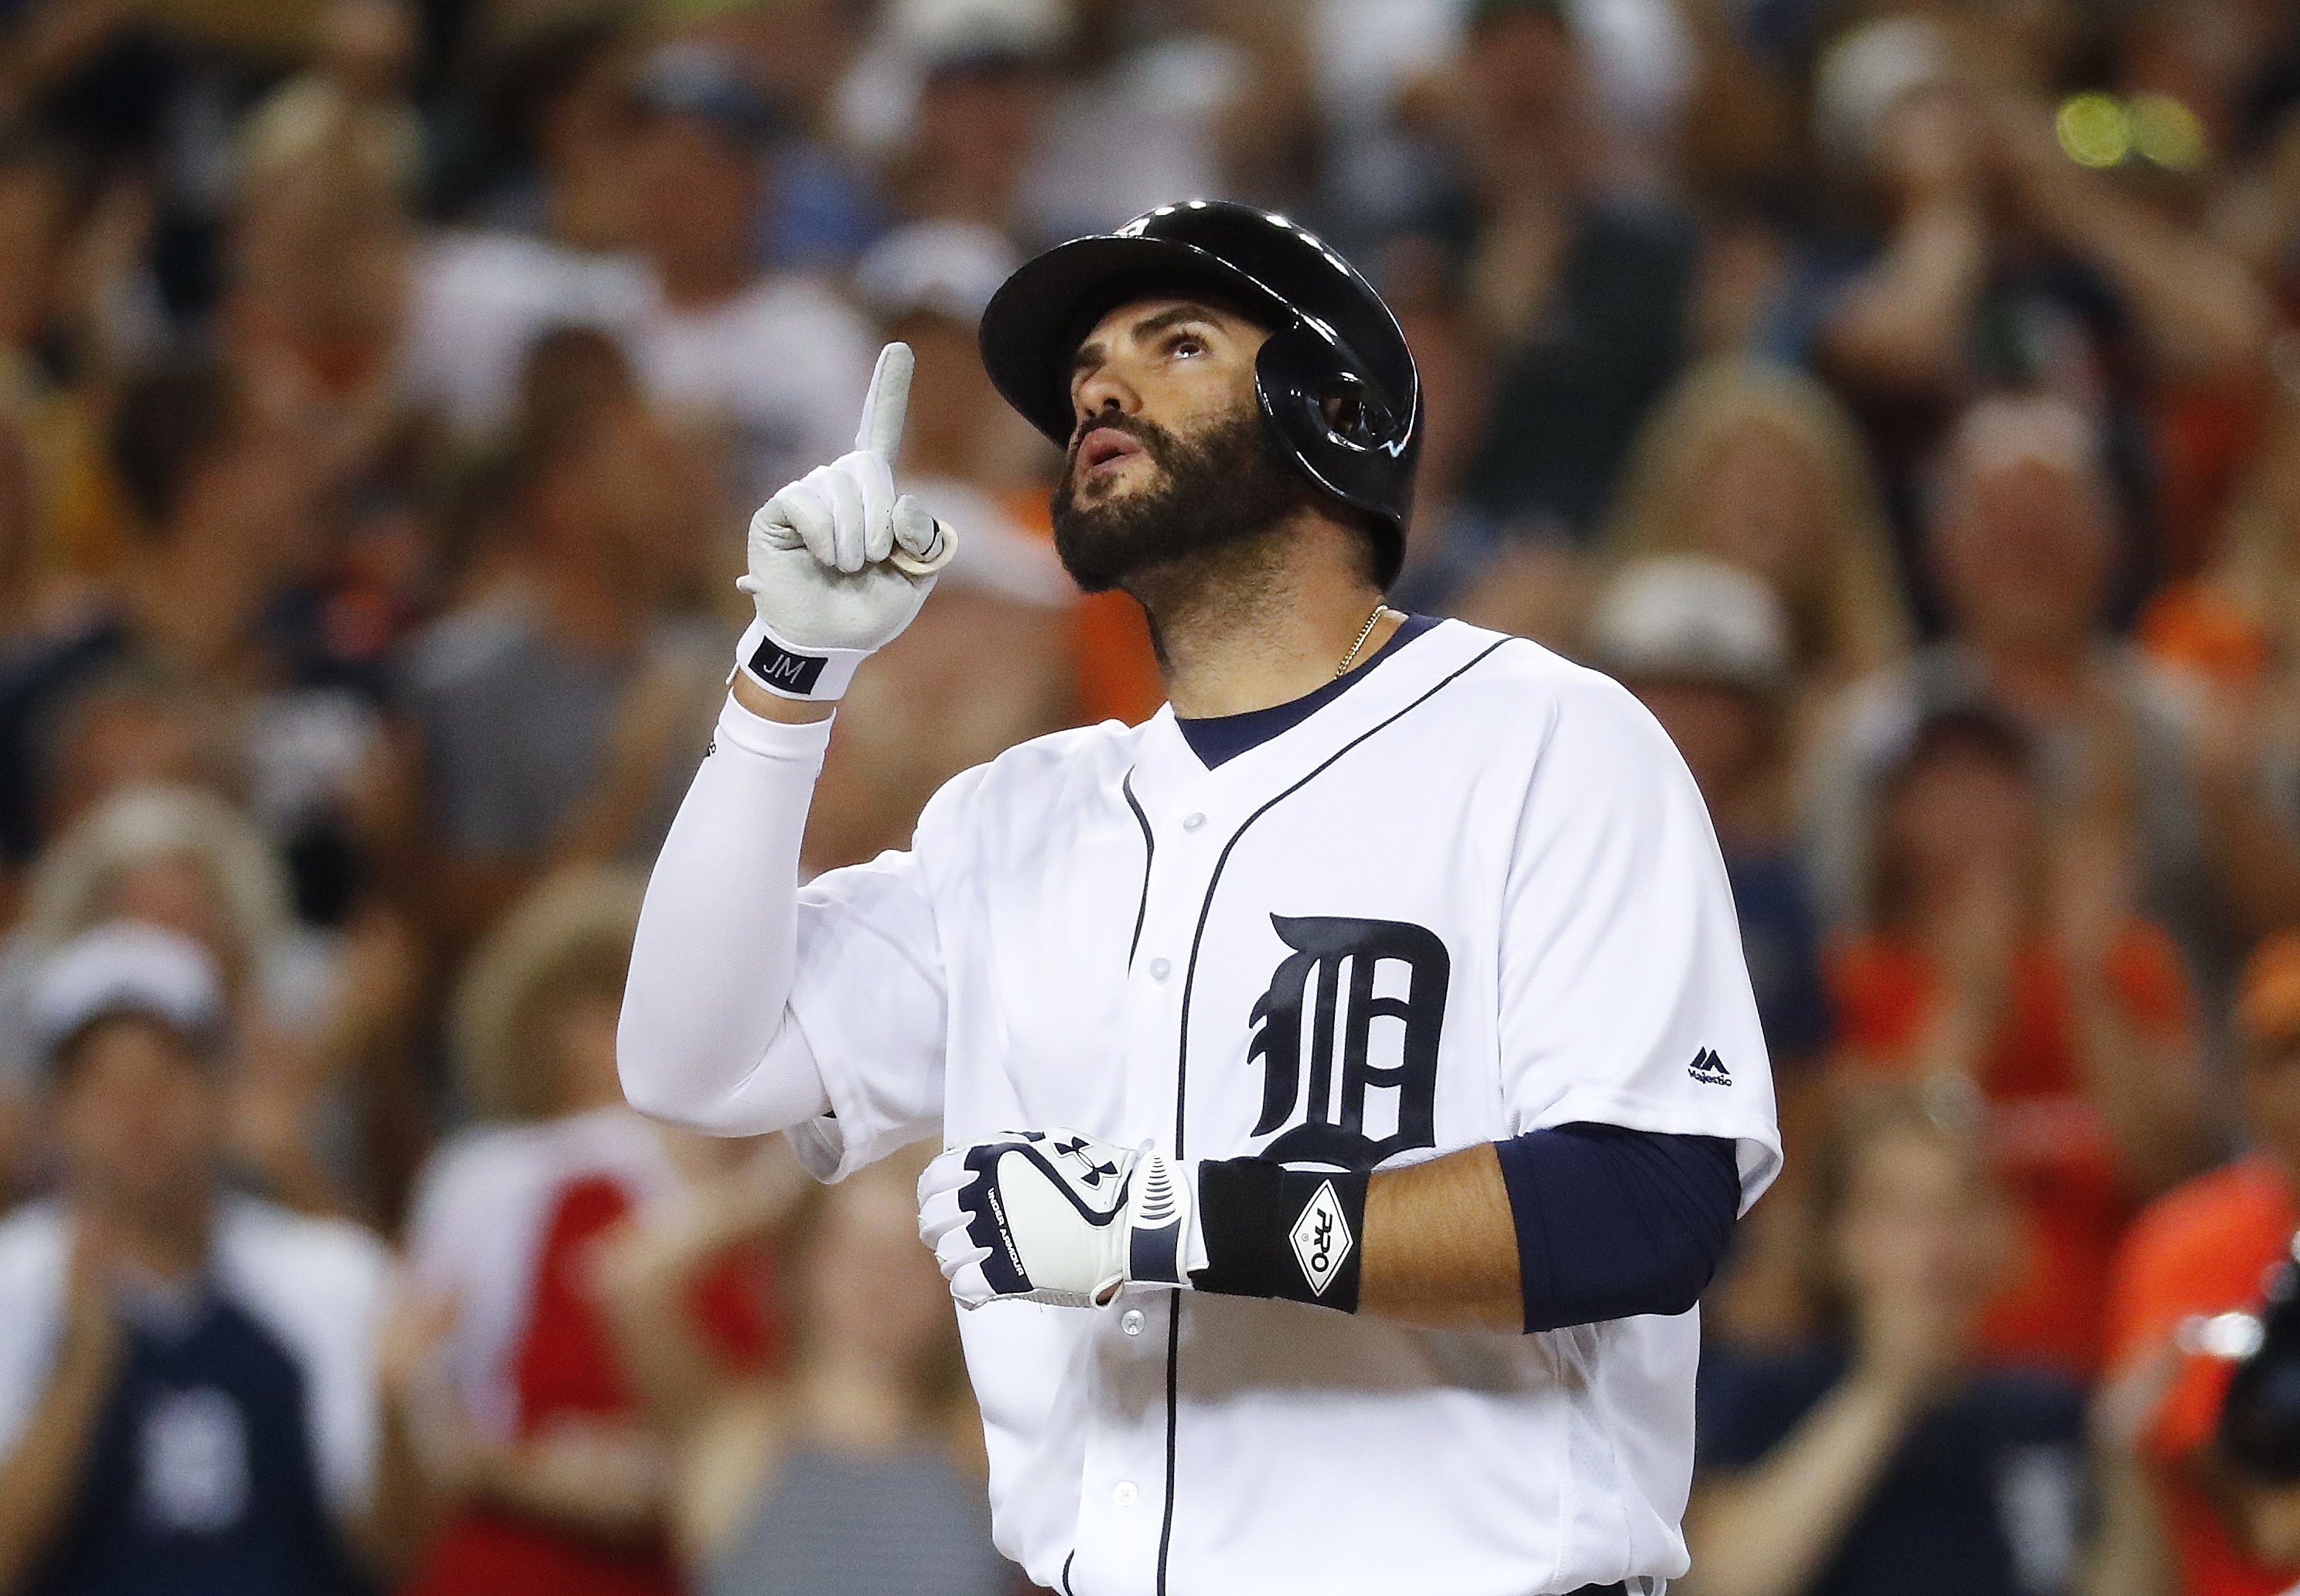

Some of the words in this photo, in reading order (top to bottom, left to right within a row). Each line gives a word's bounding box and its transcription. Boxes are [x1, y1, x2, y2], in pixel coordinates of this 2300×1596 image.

[763, 653, 807, 684] JM
[1247, 912, 1450, 1172] D
[1687, 1068, 1732, 1086] Majestic
[988, 1188, 1005, 1226] UNDER
[999, 1229, 1025, 1276] ARMOUR
[1311, 1208, 1333, 1272] PRO
